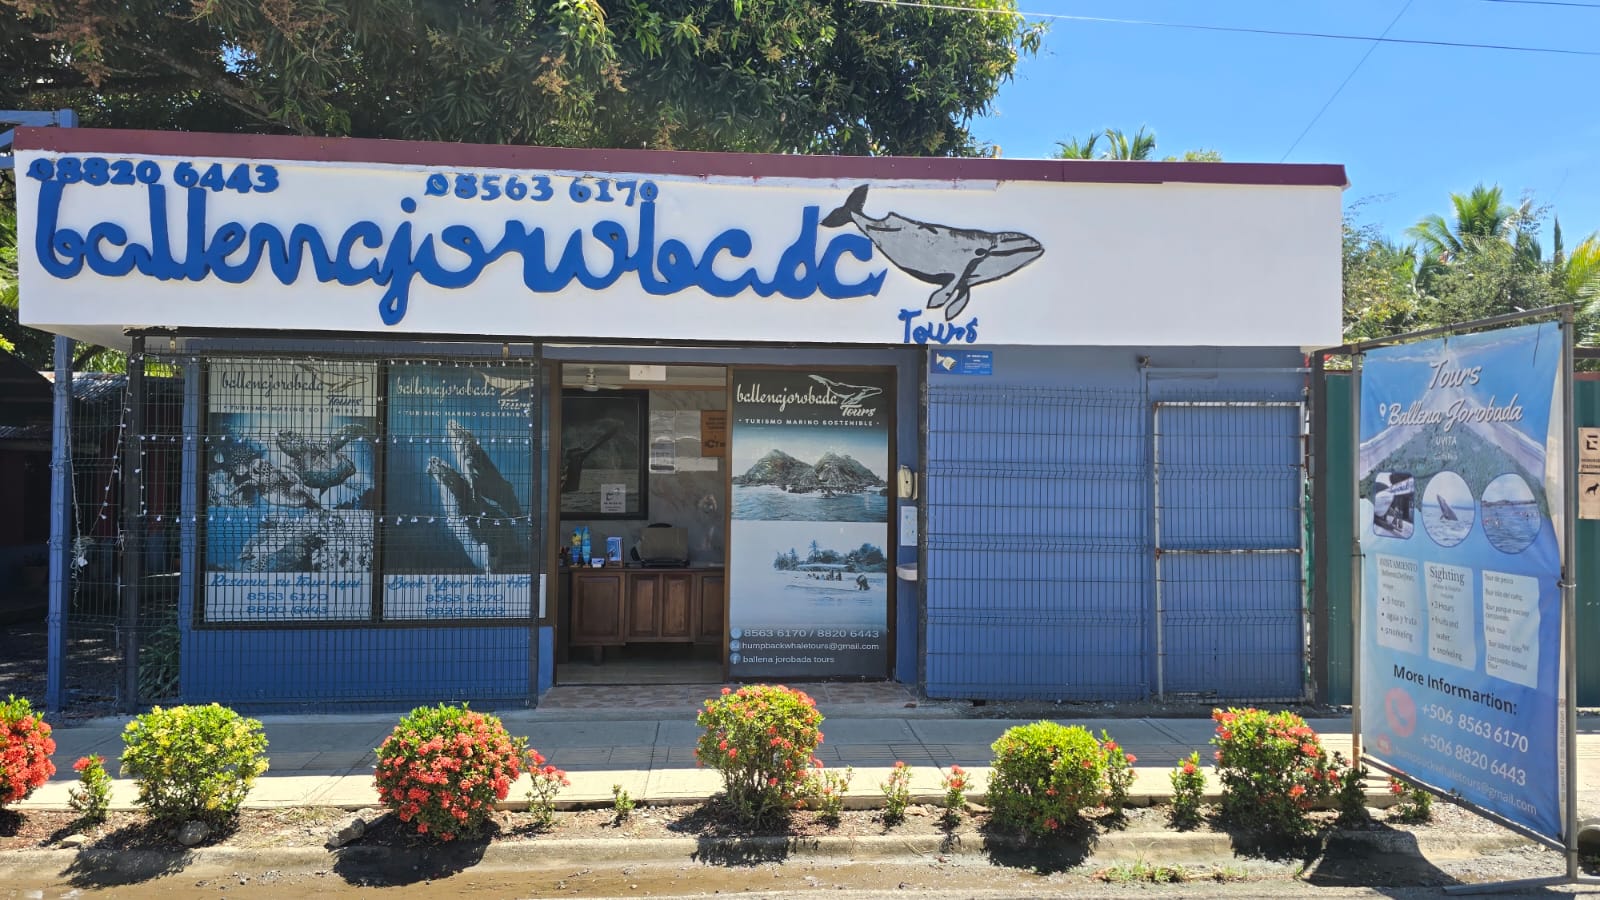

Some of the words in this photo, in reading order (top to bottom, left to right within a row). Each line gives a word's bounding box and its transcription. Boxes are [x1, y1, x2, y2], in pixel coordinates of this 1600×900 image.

[56, 157, 161, 186] 8820
[173, 161, 280, 193] 6443
[454, 173, 554, 202] 8563
[568, 177, 659, 207] 6170
[898, 308, 979, 345] Tours
[222, 371, 324, 398] ballenajorobada
[397, 375, 496, 404] ballenajorobada
[1429, 359, 1482, 390] Tours
[736, 383, 838, 412] ballenajorobada
[839, 403, 876, 417] Tours
[1388, 399, 1442, 427] Ballena
[1443, 393, 1524, 432] Jorobada
[1429, 565, 1465, 586] Sighting
[742, 641, 880, 651] humpbackwhaletours@gmail.com
[743, 629, 774, 638] 8563
[777, 629, 807, 638] 6170
[817, 629, 847, 638] 8820
[850, 629, 880, 638] 6443
[742, 655, 774, 663] ballena
[775, 655, 812, 664] jorobada
[813, 655, 835, 663] tours
[1393, 664, 1424, 686] More
[1427, 675, 1518, 715] Informartion:
[1422, 703, 1453, 725] +506
[1458, 714, 1491, 739] 8563
[1494, 727, 1529, 753] 6170
[1421, 734, 1453, 757] +506
[1455, 744, 1489, 770] 8820
[1490, 759, 1527, 786] 6443
